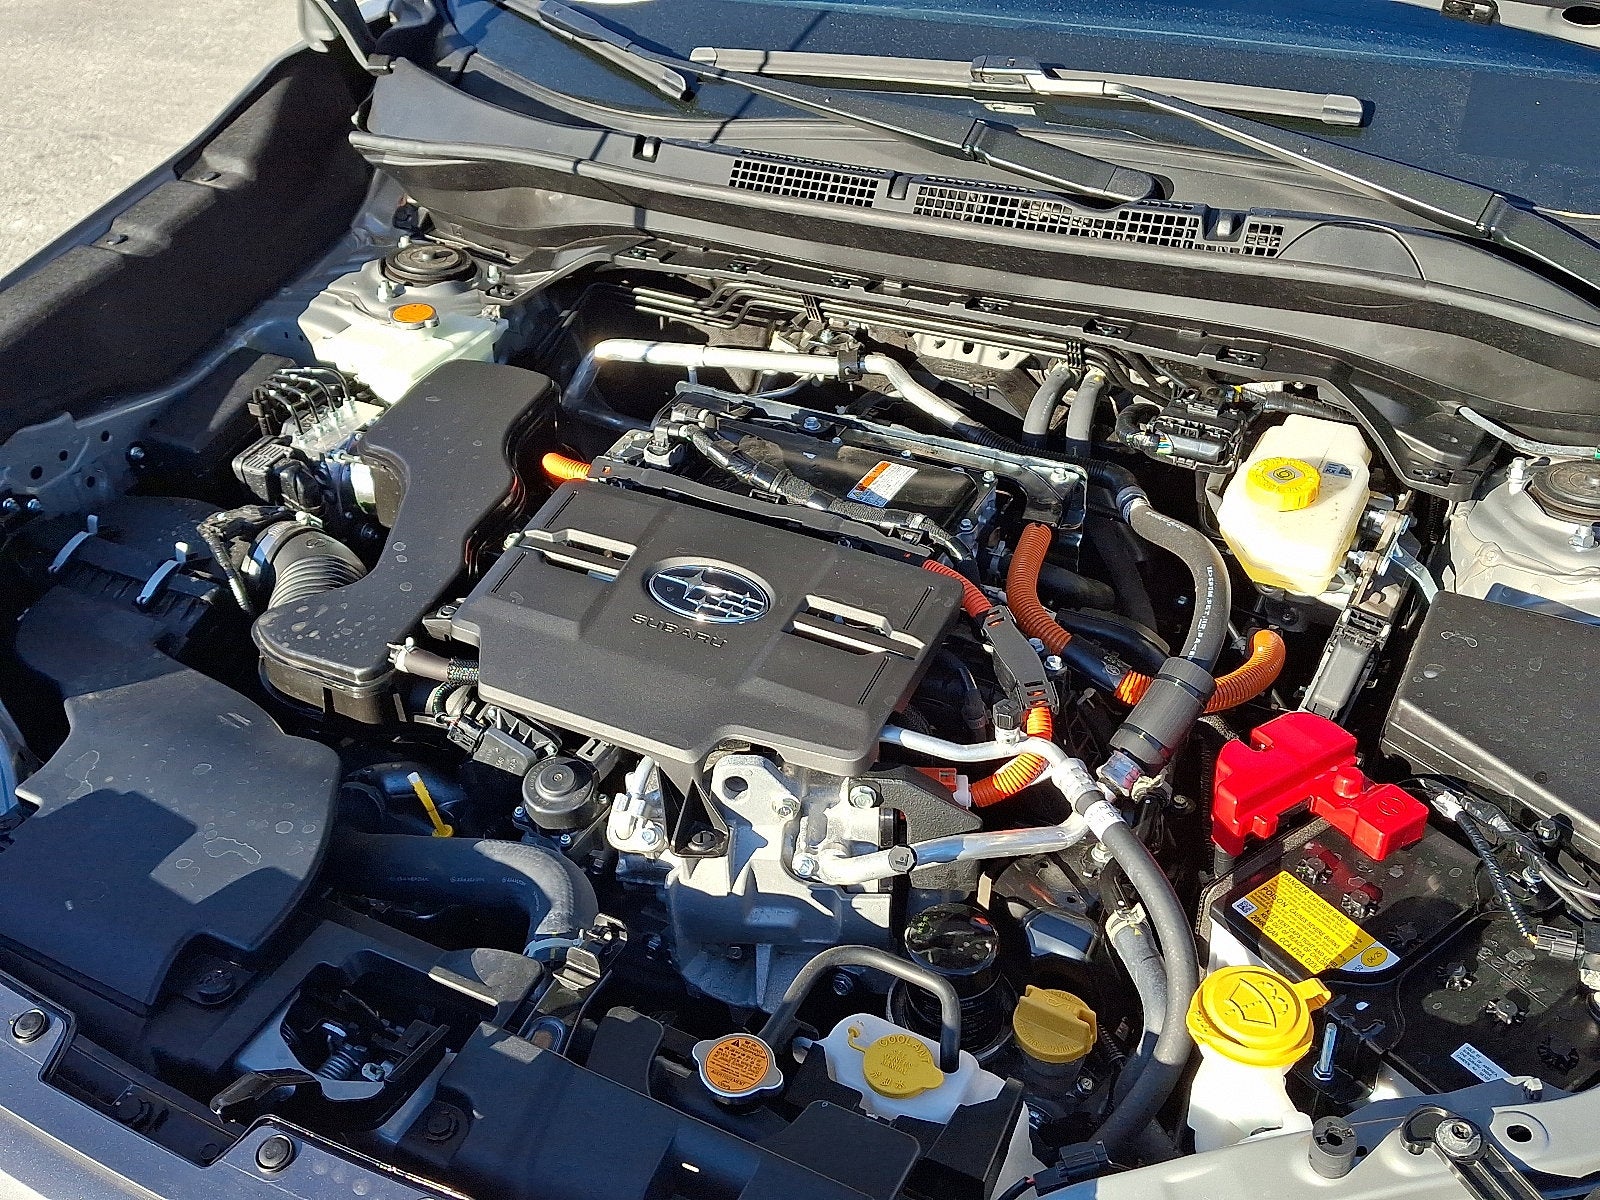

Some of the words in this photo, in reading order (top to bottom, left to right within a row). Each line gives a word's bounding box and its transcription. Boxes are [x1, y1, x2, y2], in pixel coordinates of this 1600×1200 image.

[631, 612, 728, 648] SUBARU
[1281, 873, 1310, 895] DANGER
[1261, 886, 1288, 908] POISON
[1289, 908, 1307, 923] CAUSES
[1307, 921, 1325, 937] SEVERE
[880, 1034, 931, 1064] COOLANT
